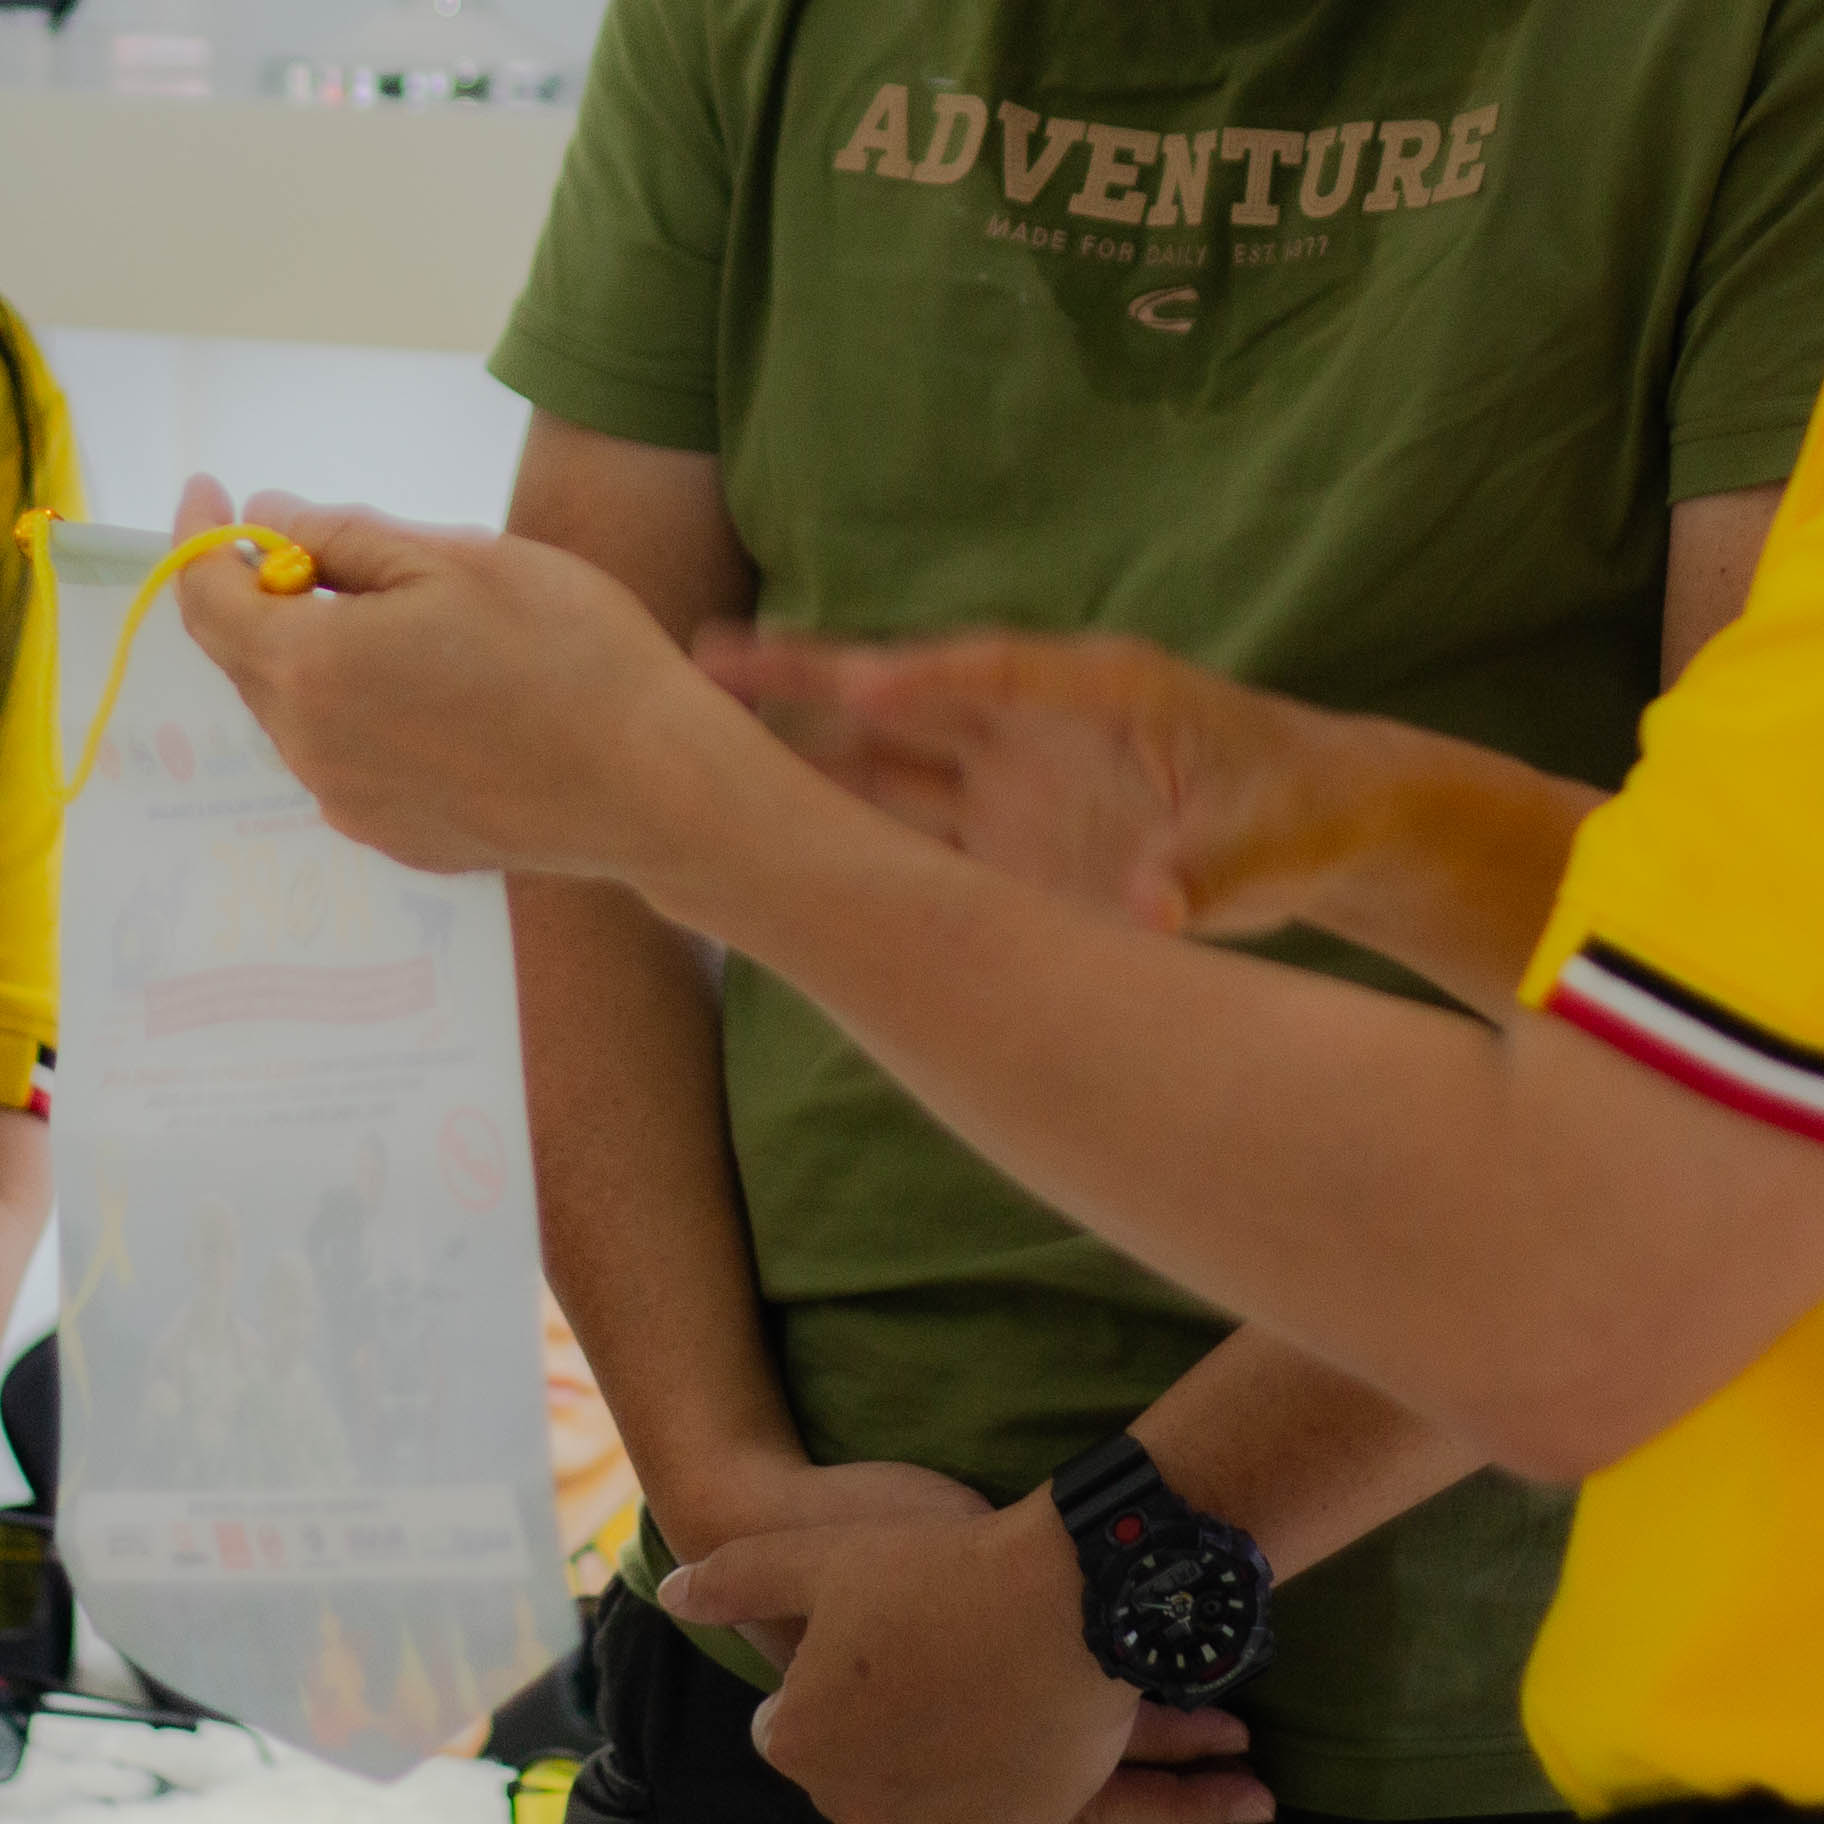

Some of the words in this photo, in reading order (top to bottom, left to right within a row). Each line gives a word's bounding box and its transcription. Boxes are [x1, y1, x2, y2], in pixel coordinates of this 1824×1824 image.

[832, 82, 1500, 227] ADVENTURE
[983, 212, 1069, 252] MADE
[1079, 234, 1136, 263] FOR
[1144, 242, 1209, 267] DAILY
